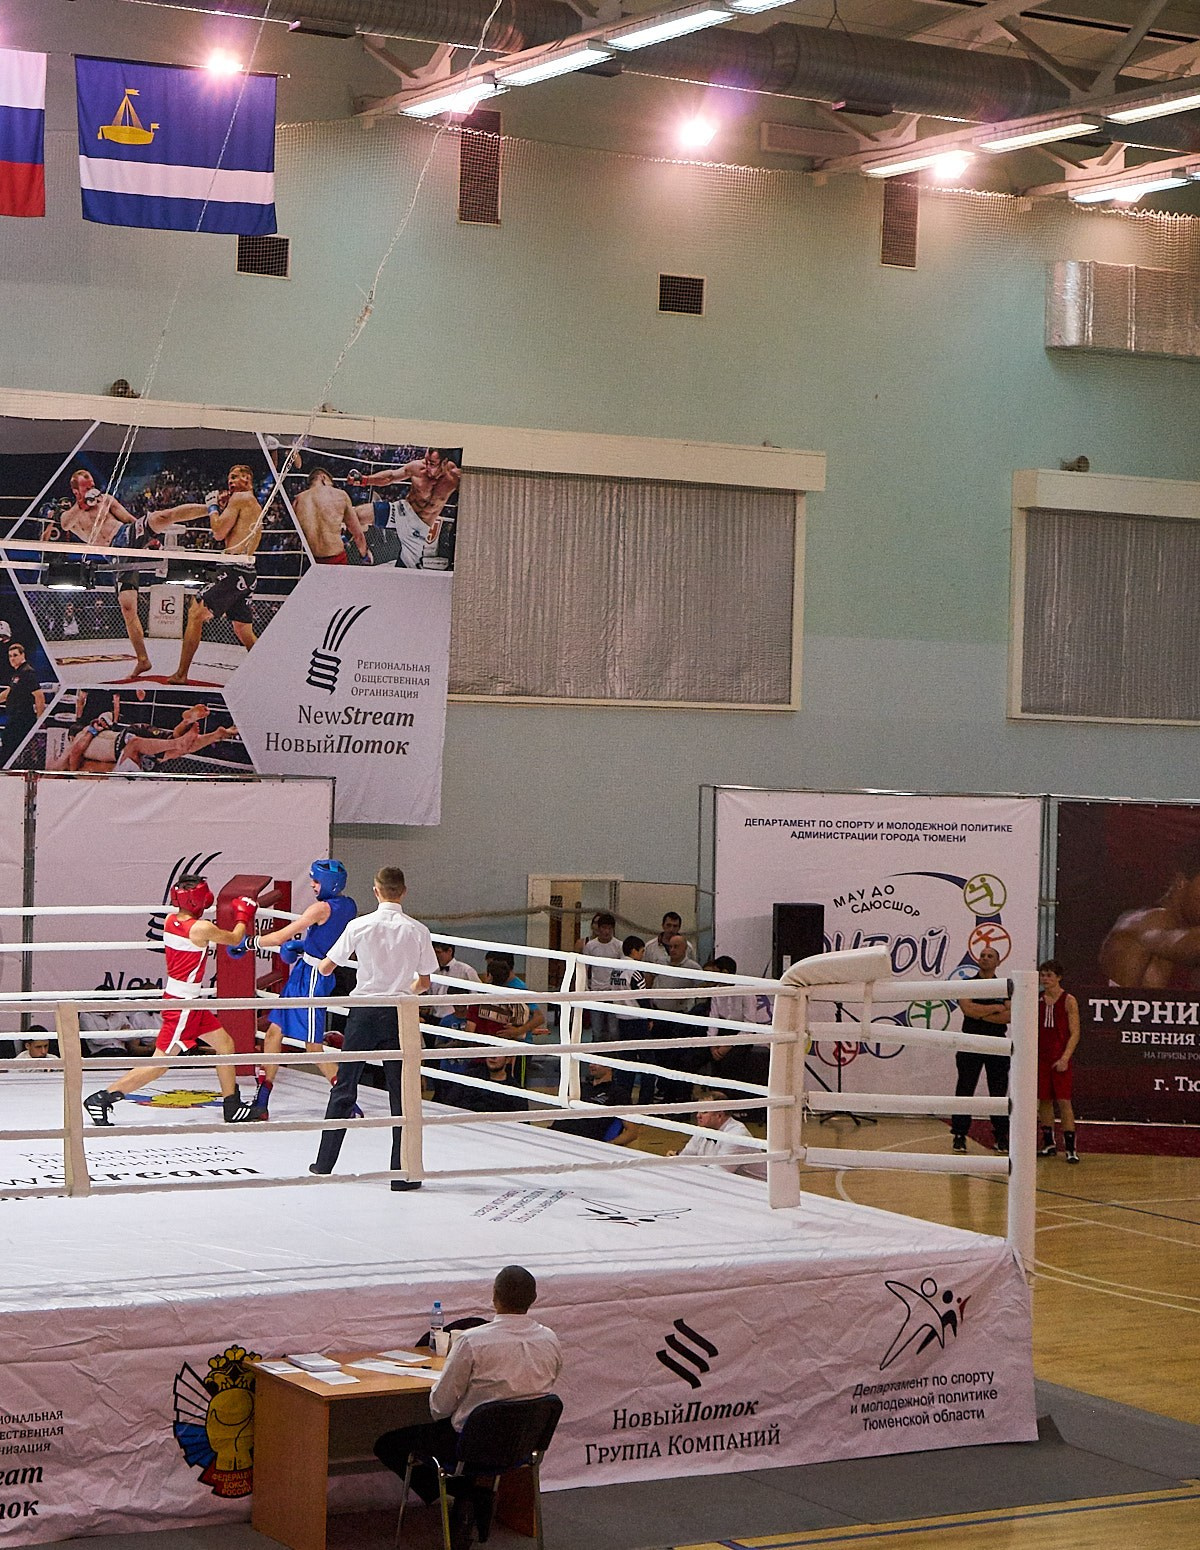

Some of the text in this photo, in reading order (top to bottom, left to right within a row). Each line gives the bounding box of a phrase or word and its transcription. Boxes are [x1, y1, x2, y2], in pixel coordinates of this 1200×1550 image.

[357, 660, 431, 673] РЕГИОНАЛЬНАЯ
[354, 673, 430, 686] ОБЩЕСТВЕННАЯ
[351, 687, 419, 699] ОРГАНИЗАЦИЯ
[298, 705, 415, 727] NewStream
[265, 732, 410, 755] НовыйПоток
[744, 818, 1013, 833] ДЕПАРТАМЕНТ ПО СПОРТУ И МОЛОДЕЖНОЙ ПОЛИТИКЕ
[790, 831, 967, 843] АДМИНИСТРАЦИИ ГОРОДА ТЮМЕНИ
[833, 884, 895, 908] МАУ ДО
[851, 900, 920, 917] СДЮСШОР
[1089, 999, 1200, 1025] ТУРНИ
[1121, 1031, 1196, 1046] ЕВГЕНИЯ
[1154, 1078, 1169, 1091] г.
[853, 1371, 994, 1399] Департамент по спорту
[850, 1389, 998, 1414] и молодежной политике
[612, 1400, 759, 1430] НовыйПоток
[863, 1408, 985, 1431] Тюменской области
[585, 1423, 781, 1465] ГРУППА КОМПАНИЙ
